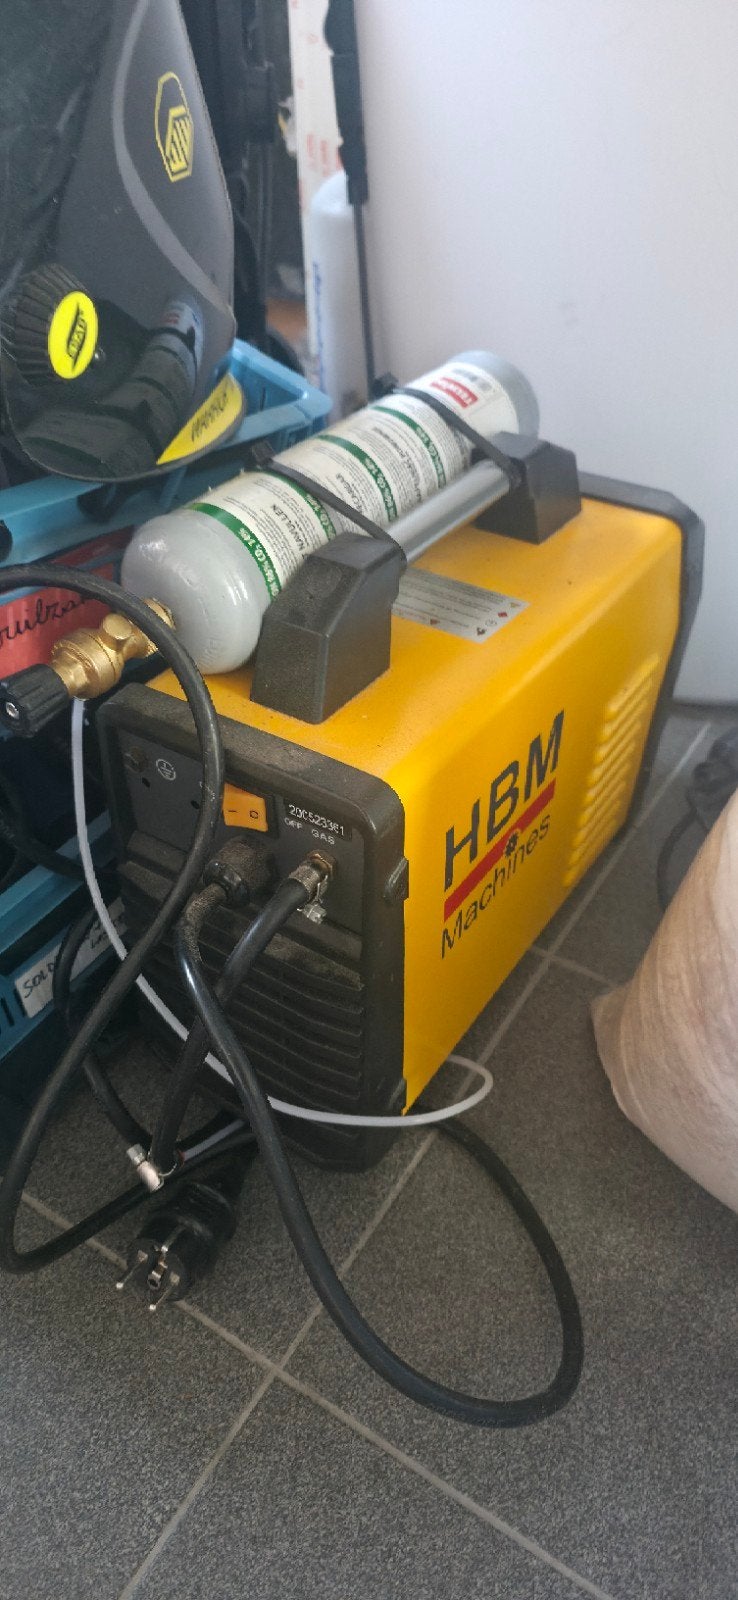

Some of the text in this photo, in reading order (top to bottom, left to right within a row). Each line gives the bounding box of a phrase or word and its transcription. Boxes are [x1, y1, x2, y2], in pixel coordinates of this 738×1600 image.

[311, 828, 335, 845] GAS
[443, 708, 564, 892] HBM
[441, 814, 550, 960] Machines
